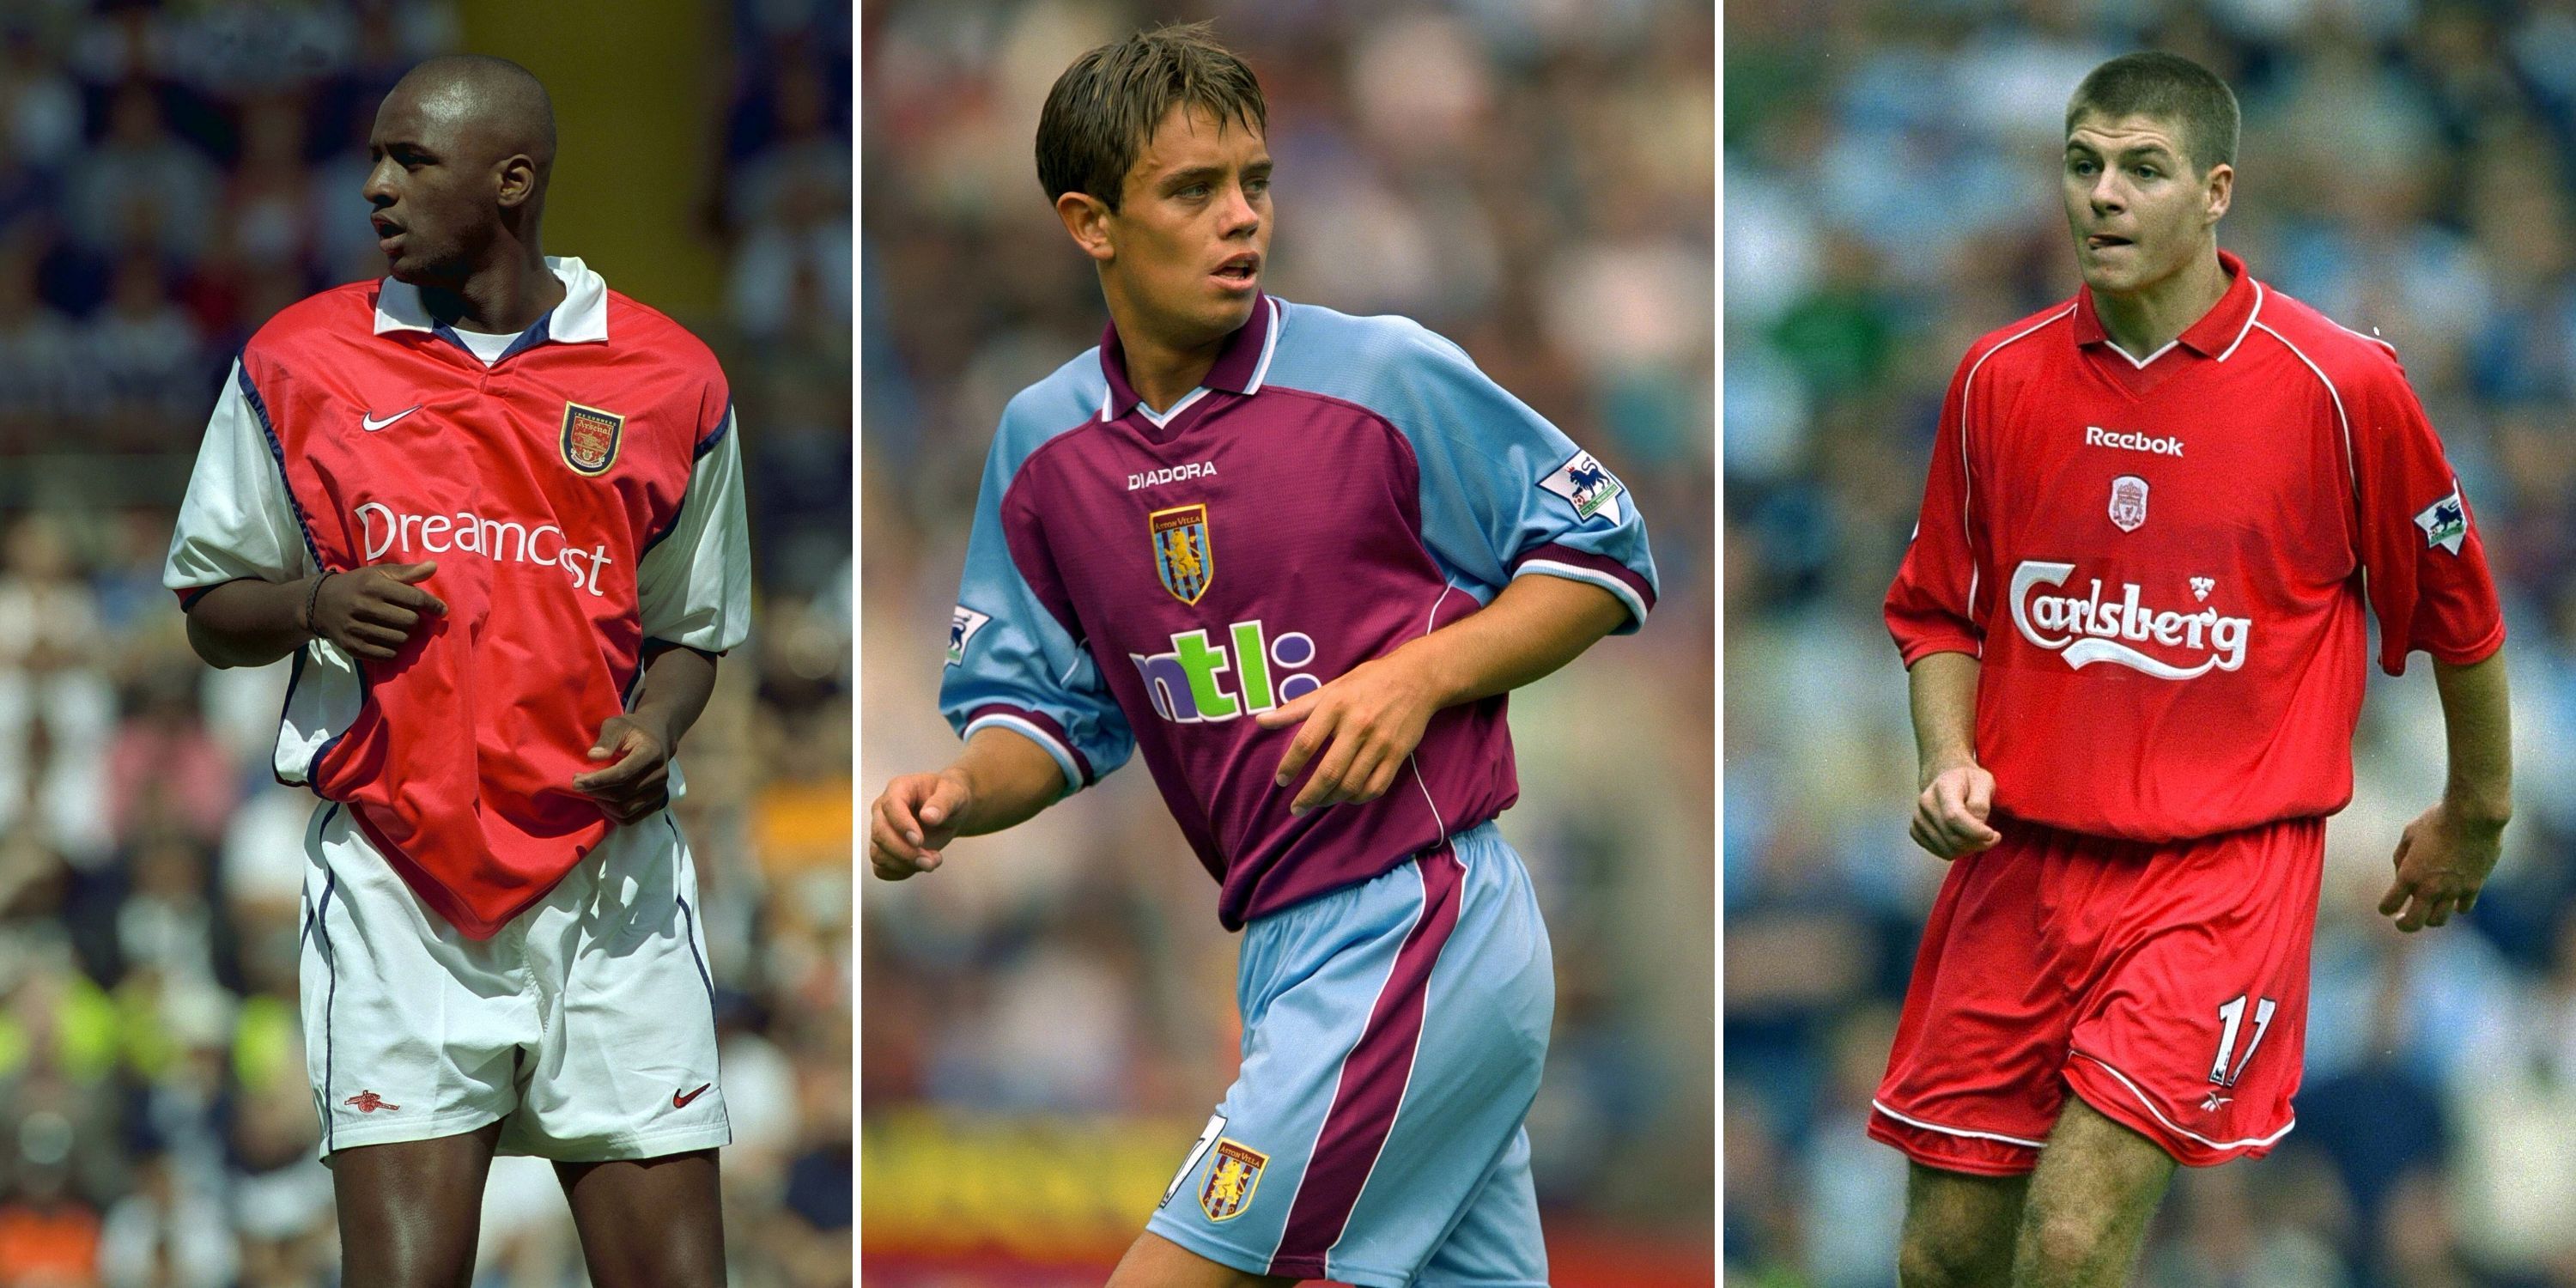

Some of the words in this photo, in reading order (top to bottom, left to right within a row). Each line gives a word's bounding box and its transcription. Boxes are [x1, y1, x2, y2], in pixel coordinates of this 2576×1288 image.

[578, 419, 612, 435] Arsenal
[2086, 426, 2184, 458] Reebok
[1128, 461, 1217, 490] DIADORA
[2009, 561, 2251, 680] Carlsberg
[2208, 994, 2277, 1088] 17
[1219, 1145, 1241, 1158] ASTON
[1241, 1152, 1260, 1167] VILLA
